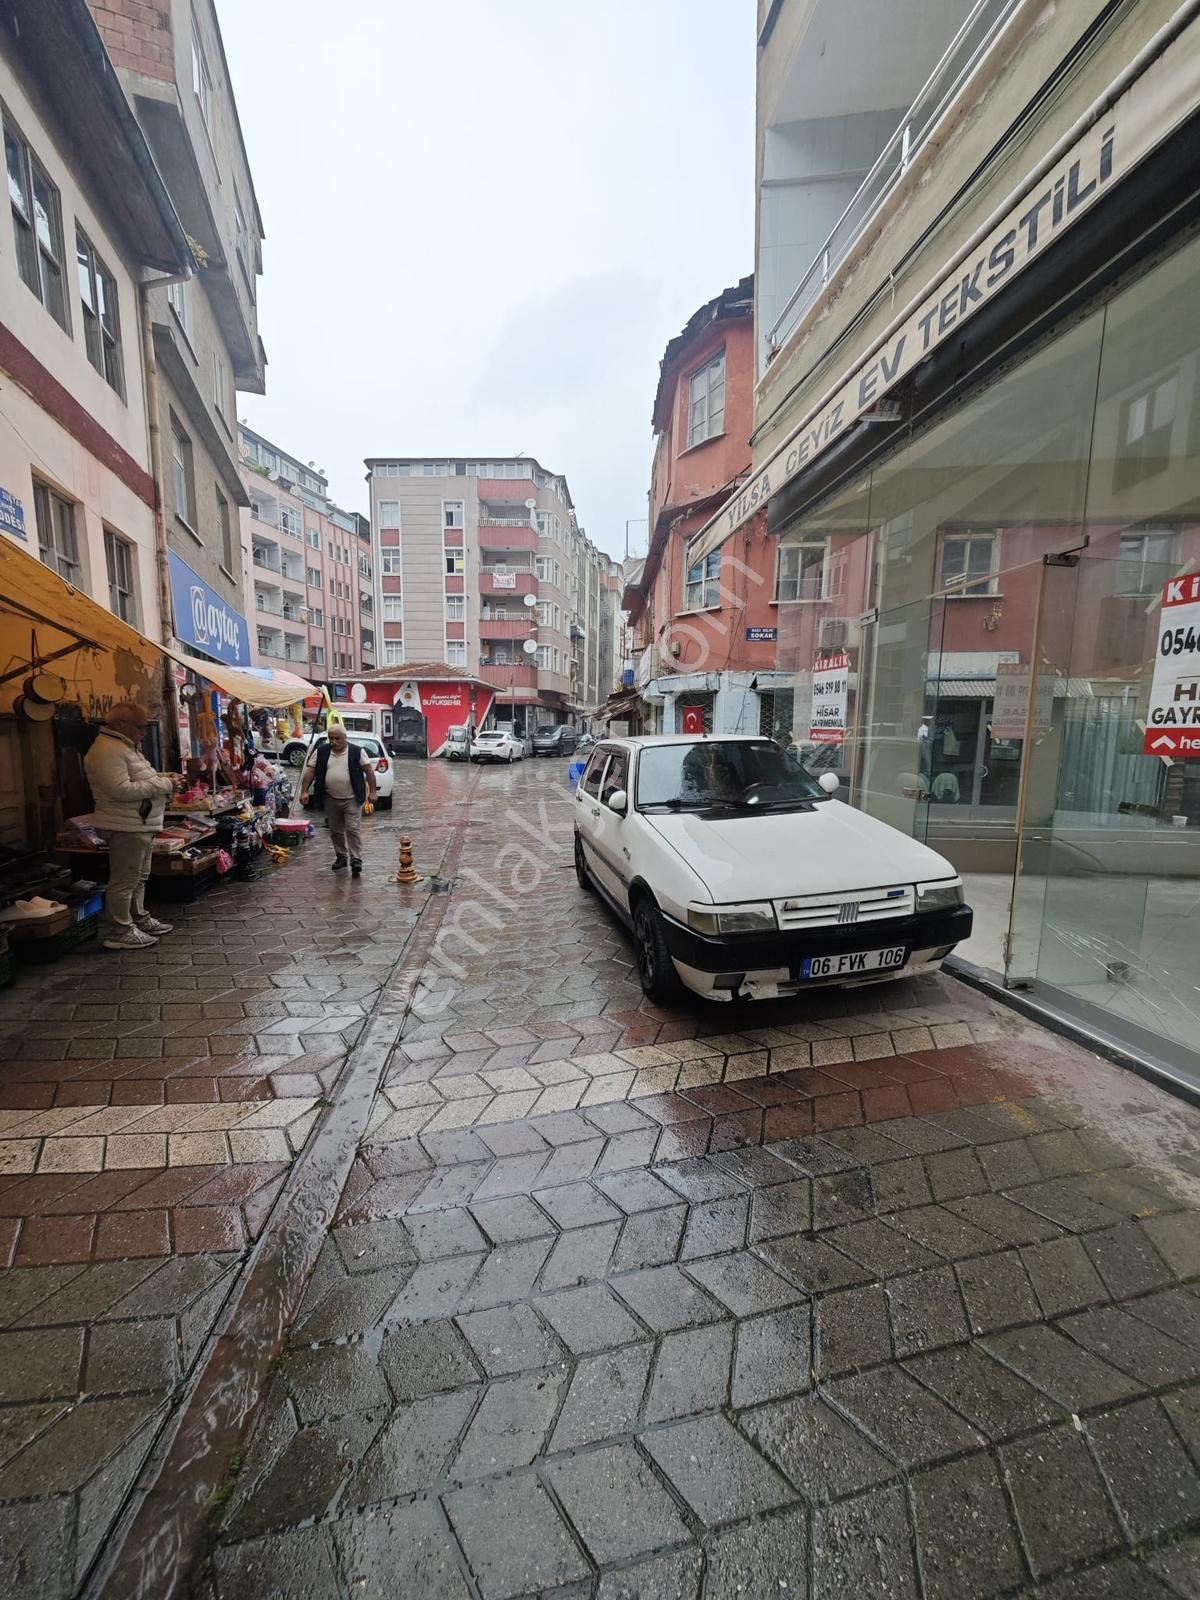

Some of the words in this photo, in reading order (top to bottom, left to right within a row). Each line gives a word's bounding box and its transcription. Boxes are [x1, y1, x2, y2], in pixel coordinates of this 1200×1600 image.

[858, 334, 907, 410] EV
[813, 682, 824, 696] 0546
[825, 681, 834, 694] 519
[834, 680, 841, 694] 88
[1173, 683, 1200, 702] H
[811, 958, 831, 976] 06
[838, 953, 867, 973] FVK
[878, 948, 903, 967] 106
